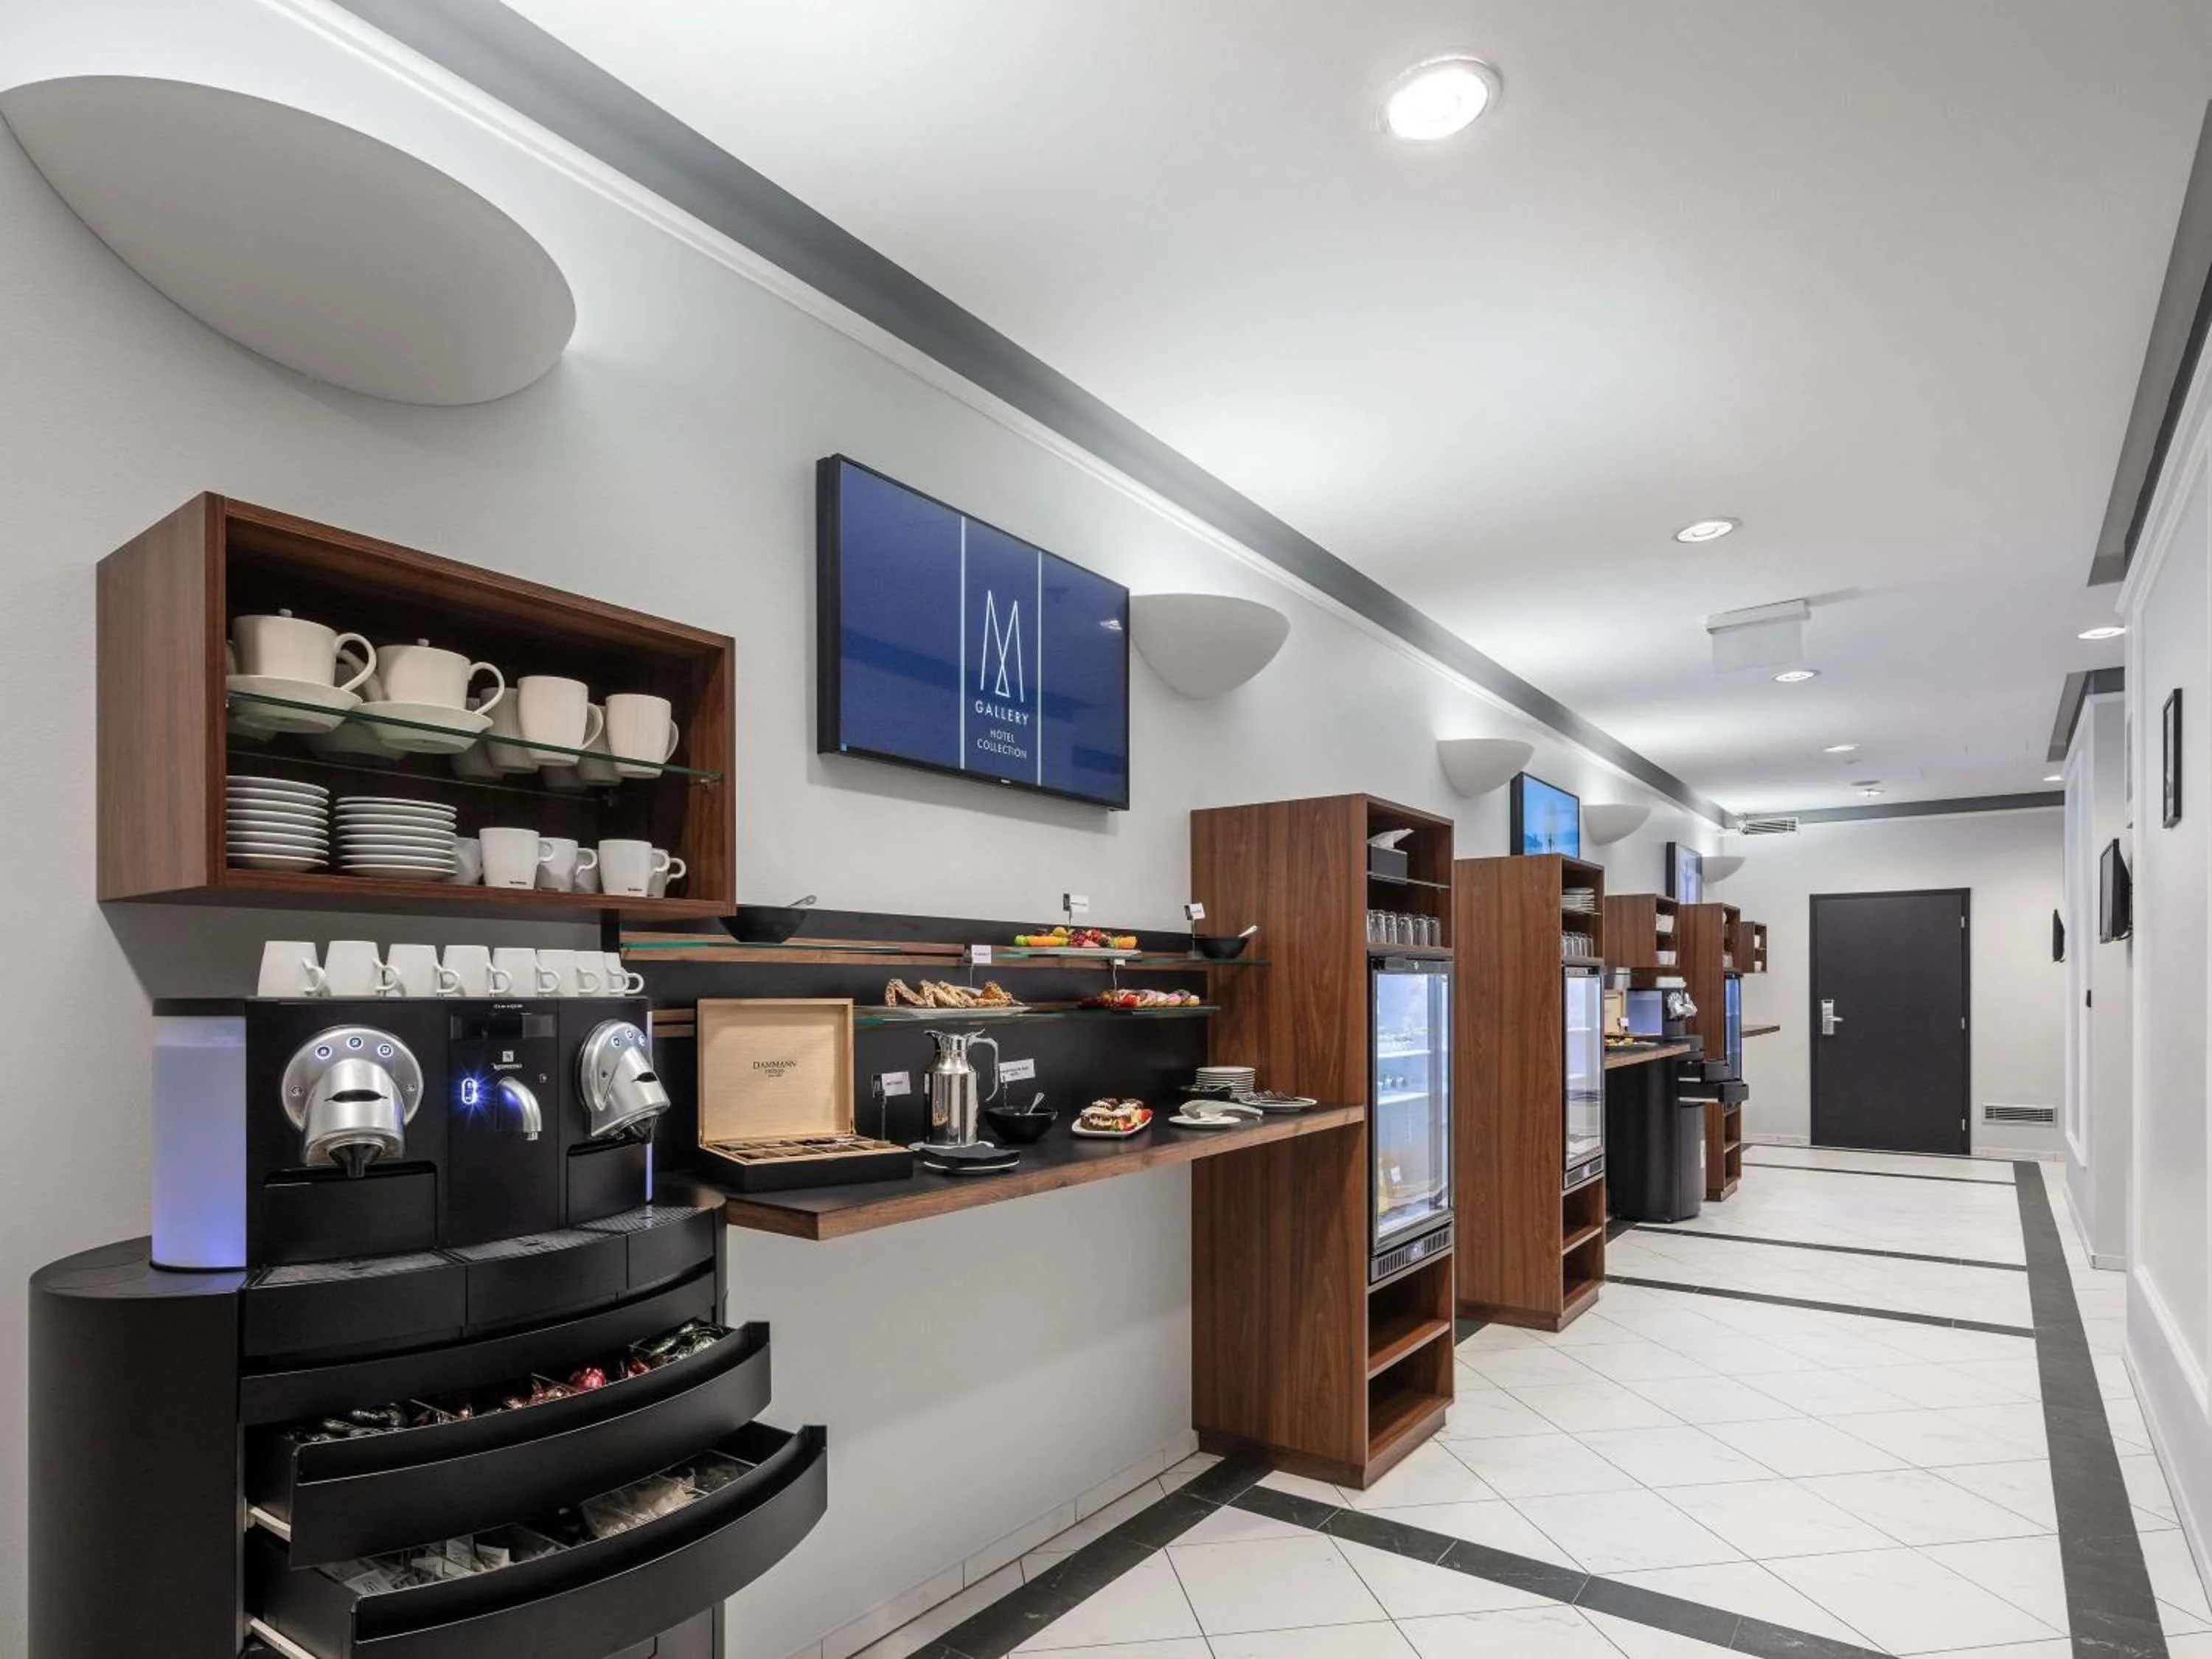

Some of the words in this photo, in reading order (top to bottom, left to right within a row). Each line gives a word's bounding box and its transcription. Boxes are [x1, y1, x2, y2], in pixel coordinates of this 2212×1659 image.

[975, 700, 1029, 726] GALLERY
[990, 728, 1015, 743] HOTEL
[977, 738, 1027, 759] COLLECTION
